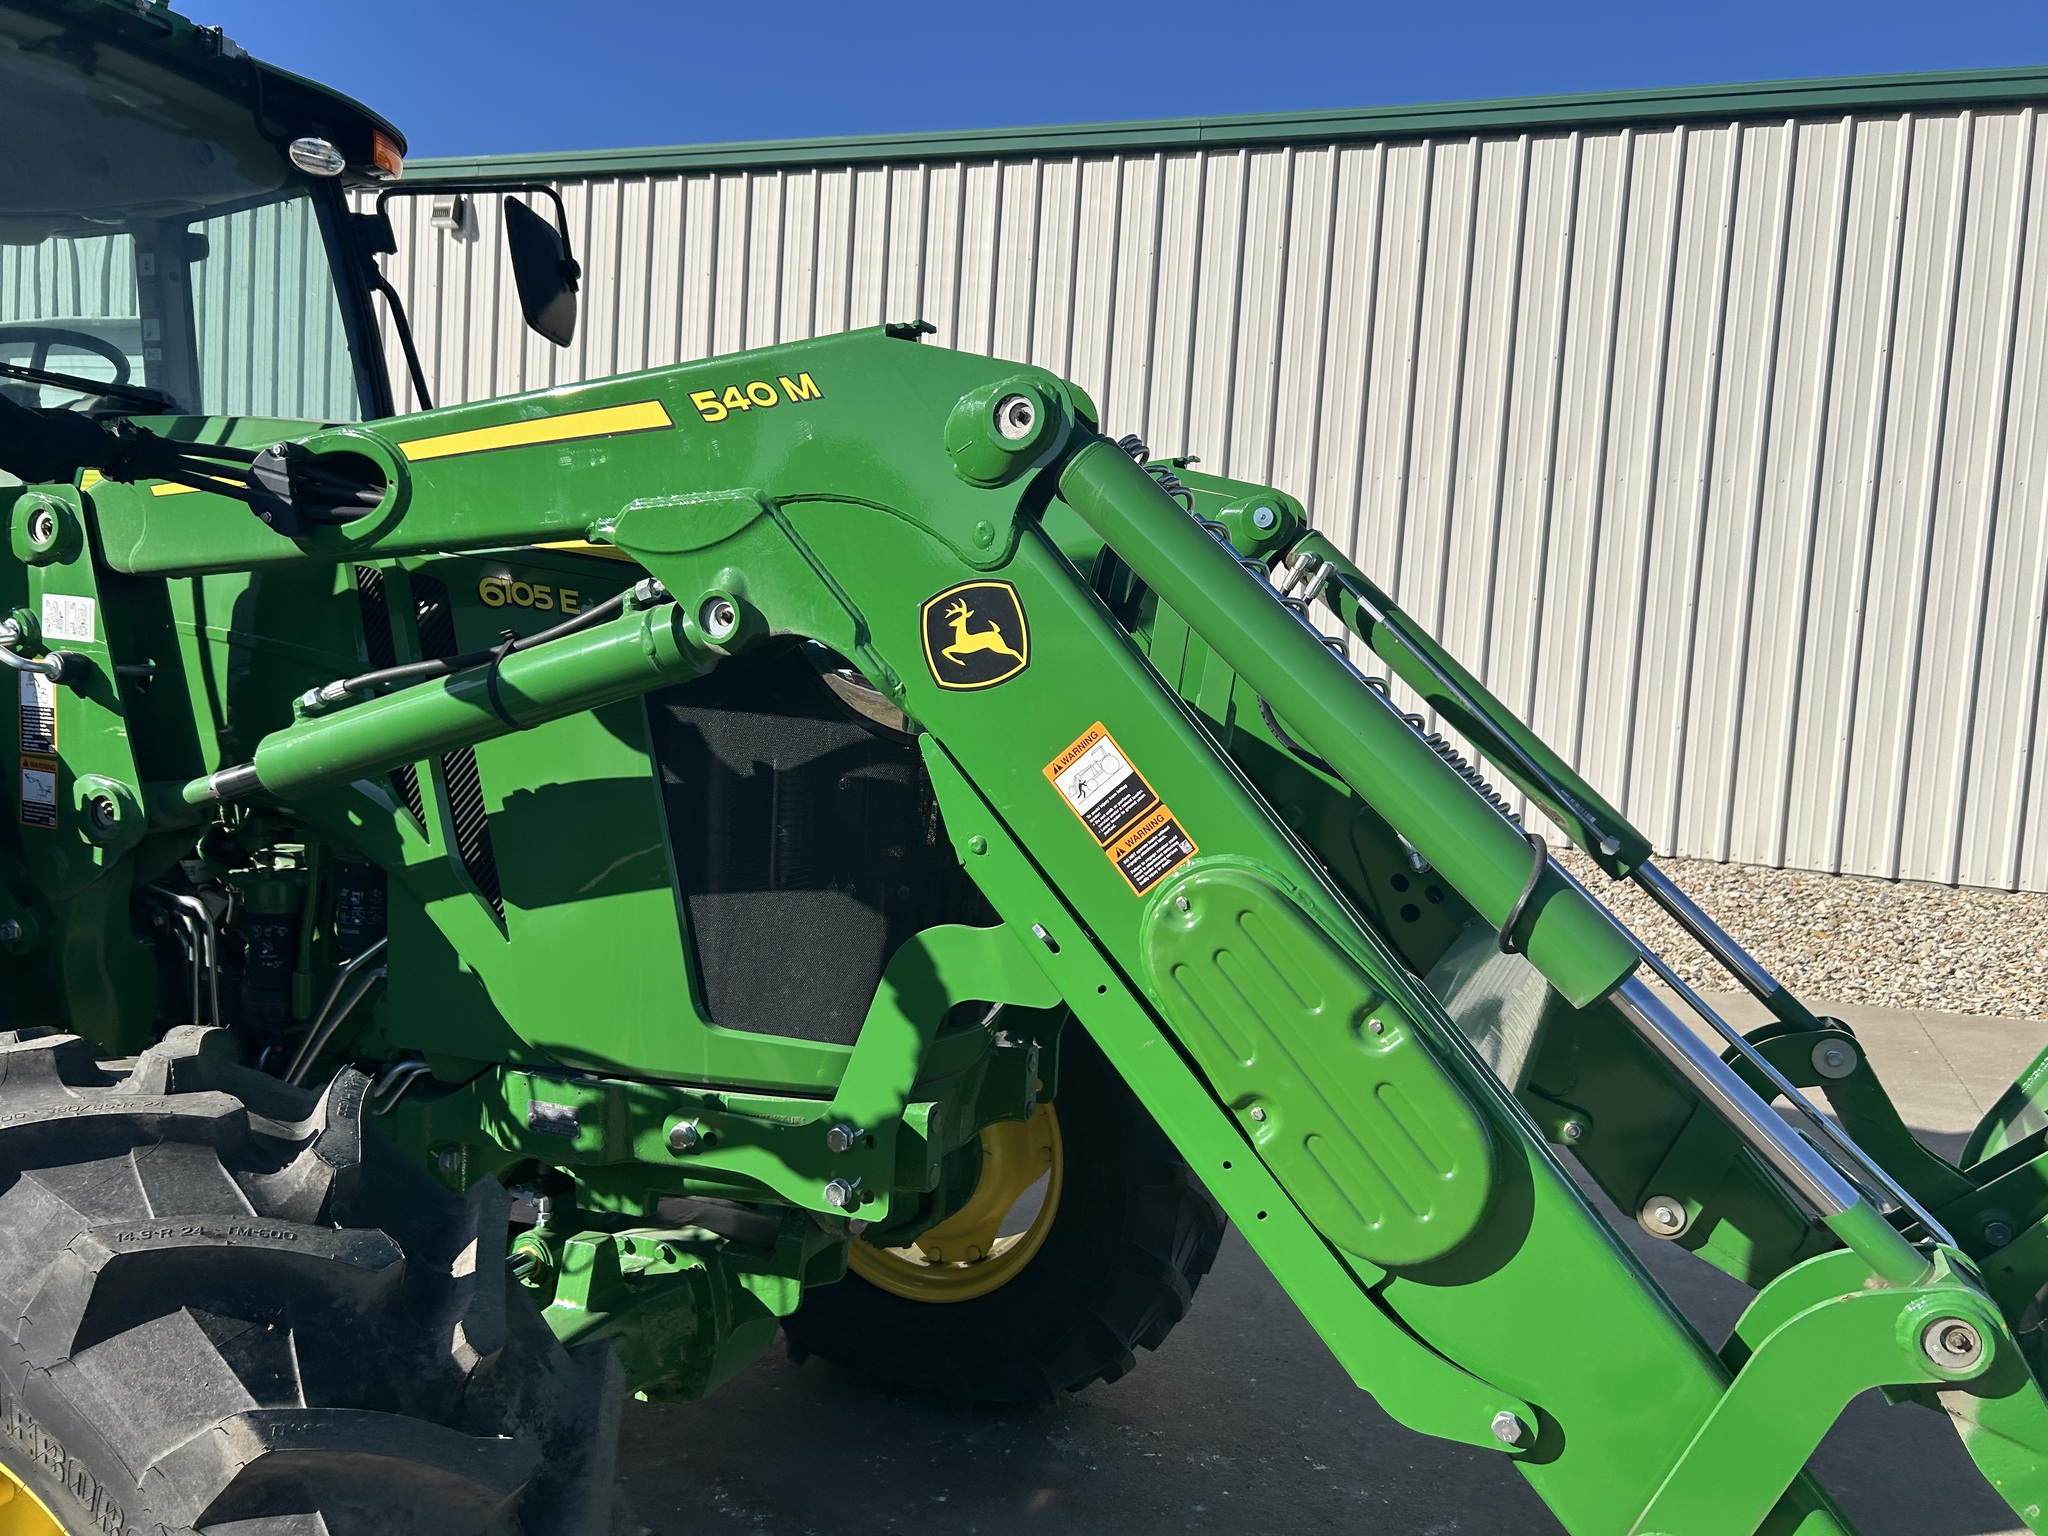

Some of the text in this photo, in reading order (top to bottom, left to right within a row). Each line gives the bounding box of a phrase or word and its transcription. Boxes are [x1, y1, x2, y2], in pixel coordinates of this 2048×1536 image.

[688, 372, 824, 423] 540 M
[479, 576, 581, 615] 6105 E
[30, 761, 56, 771] WARNING
[1060, 731, 1099, 766] WARNING
[1125, 814, 1165, 848] WARNING
[1511, 966, 1550, 1021] DEER
[180, 1225, 204, 1237] 24
